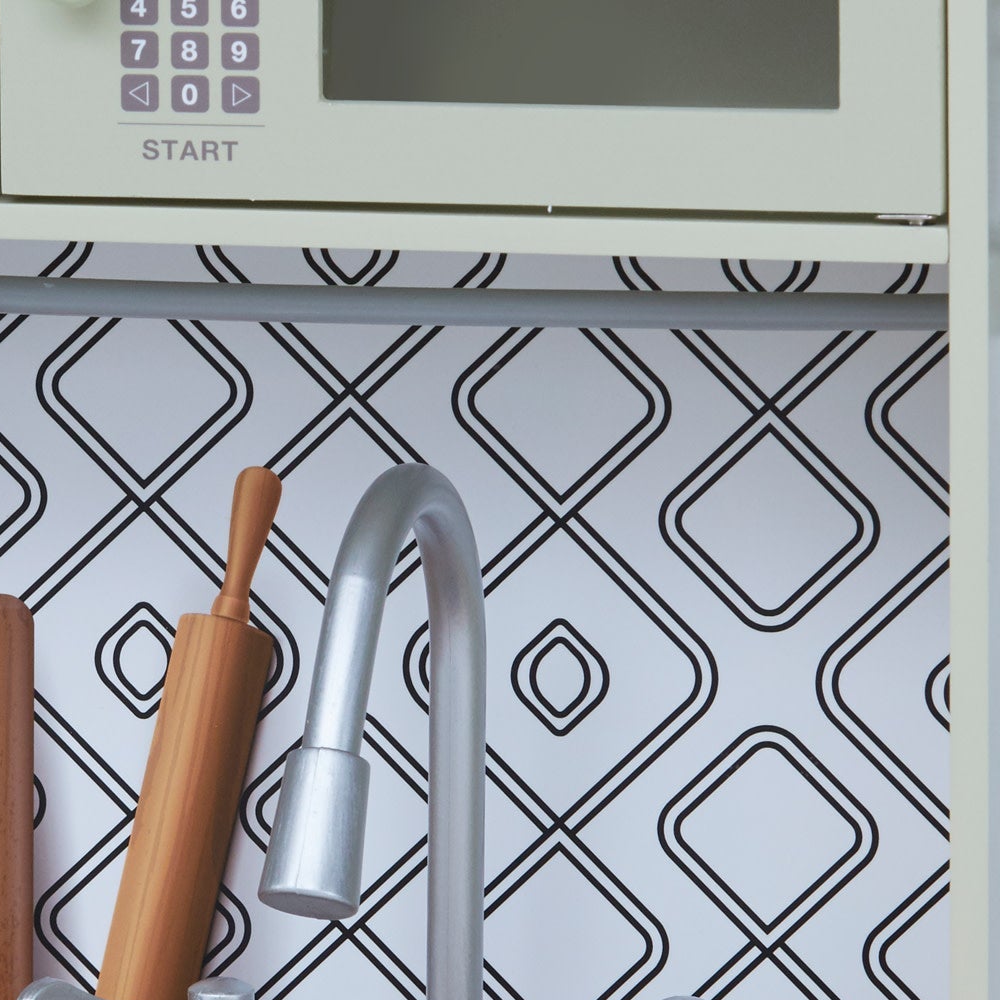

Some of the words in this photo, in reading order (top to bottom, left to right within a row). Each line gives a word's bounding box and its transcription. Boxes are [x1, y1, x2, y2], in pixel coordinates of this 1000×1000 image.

[130, 0, 147, 17] 4
[180, 0, 197, 19] 5
[230, 0, 247, 20] 6
[131, 39, 147, 61] 7
[181, 39, 198, 62] 8
[230, 40, 248, 63] 9
[181, 83, 198, 106] 0
[142, 138, 239, 162] START
